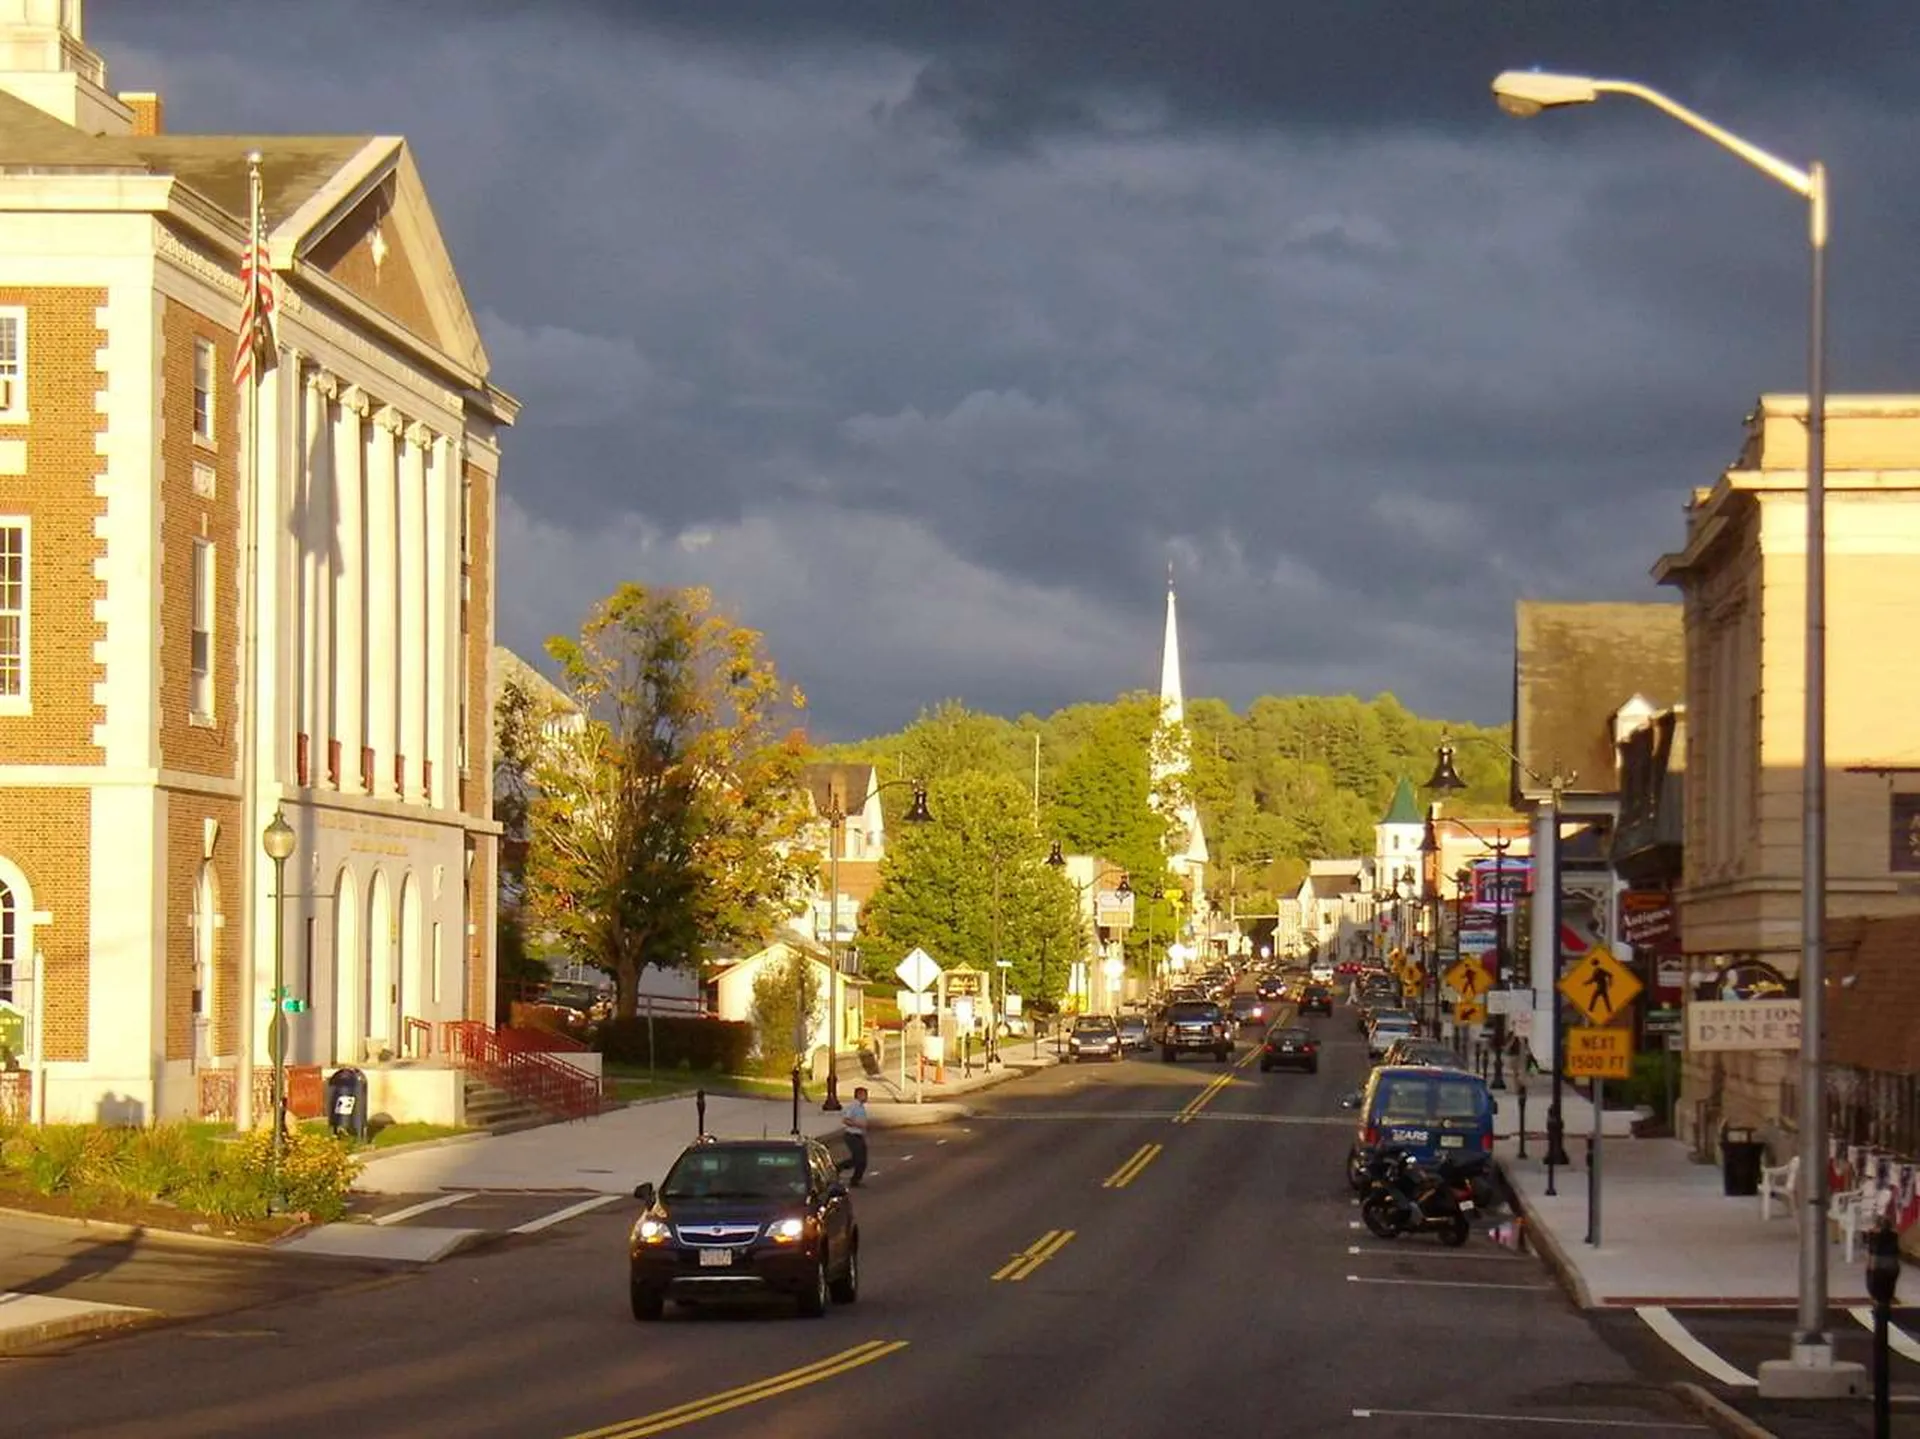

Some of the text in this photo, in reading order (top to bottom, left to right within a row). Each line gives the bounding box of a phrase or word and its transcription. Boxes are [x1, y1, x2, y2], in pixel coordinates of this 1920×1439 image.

[1581, 1035, 1615, 1050] NEXT
[1571, 1055, 1624, 1070] 1500 FT
